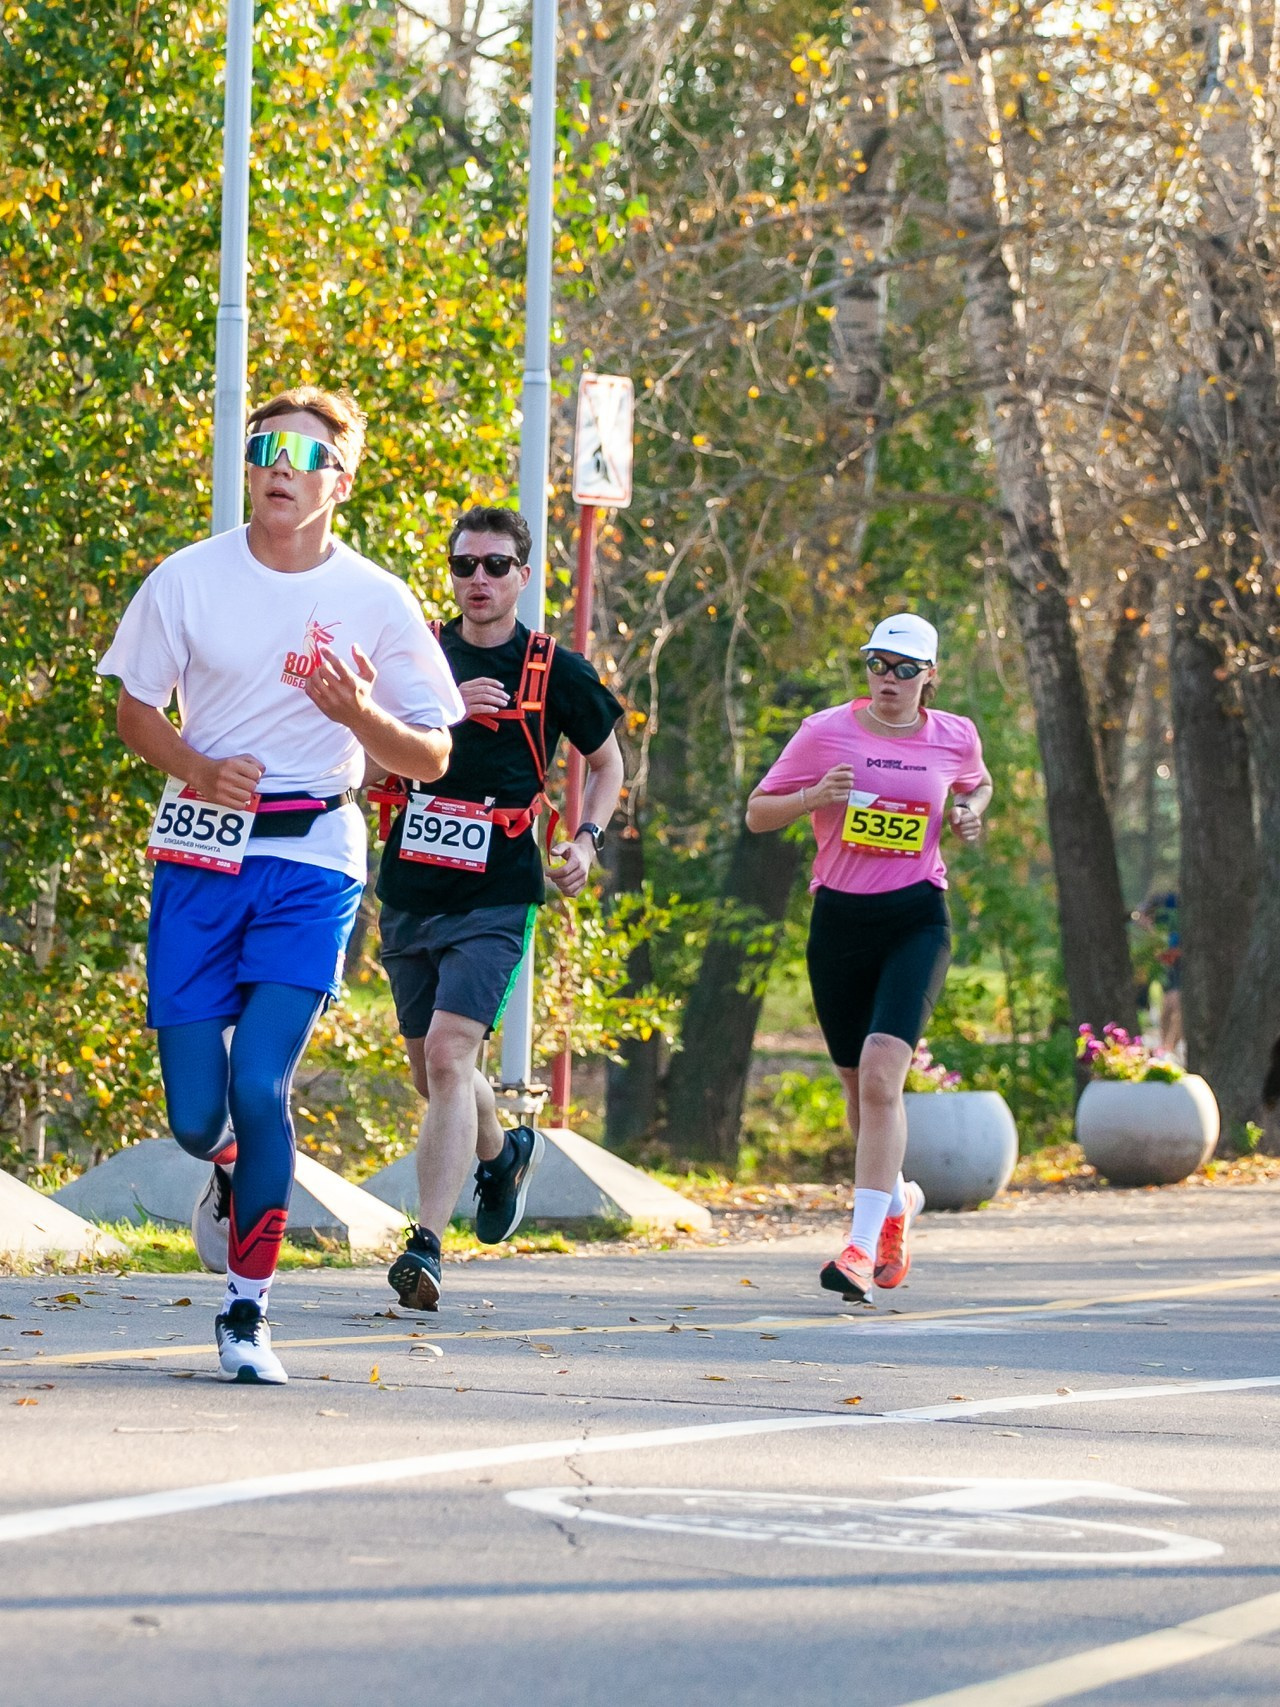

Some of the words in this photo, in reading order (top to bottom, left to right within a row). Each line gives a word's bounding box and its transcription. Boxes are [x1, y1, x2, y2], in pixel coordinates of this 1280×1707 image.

[284, 651, 309, 675] 80
[280, 673, 306, 690] ПОБЕ
[157, 803, 245, 846] 5858
[406, 814, 485, 850] 5920
[850, 811, 920, 841] 5352
[163, 837, 195, 847] ЕЛИЗАРЬЕВ
[195, 842, 221, 853] НИКИТА
